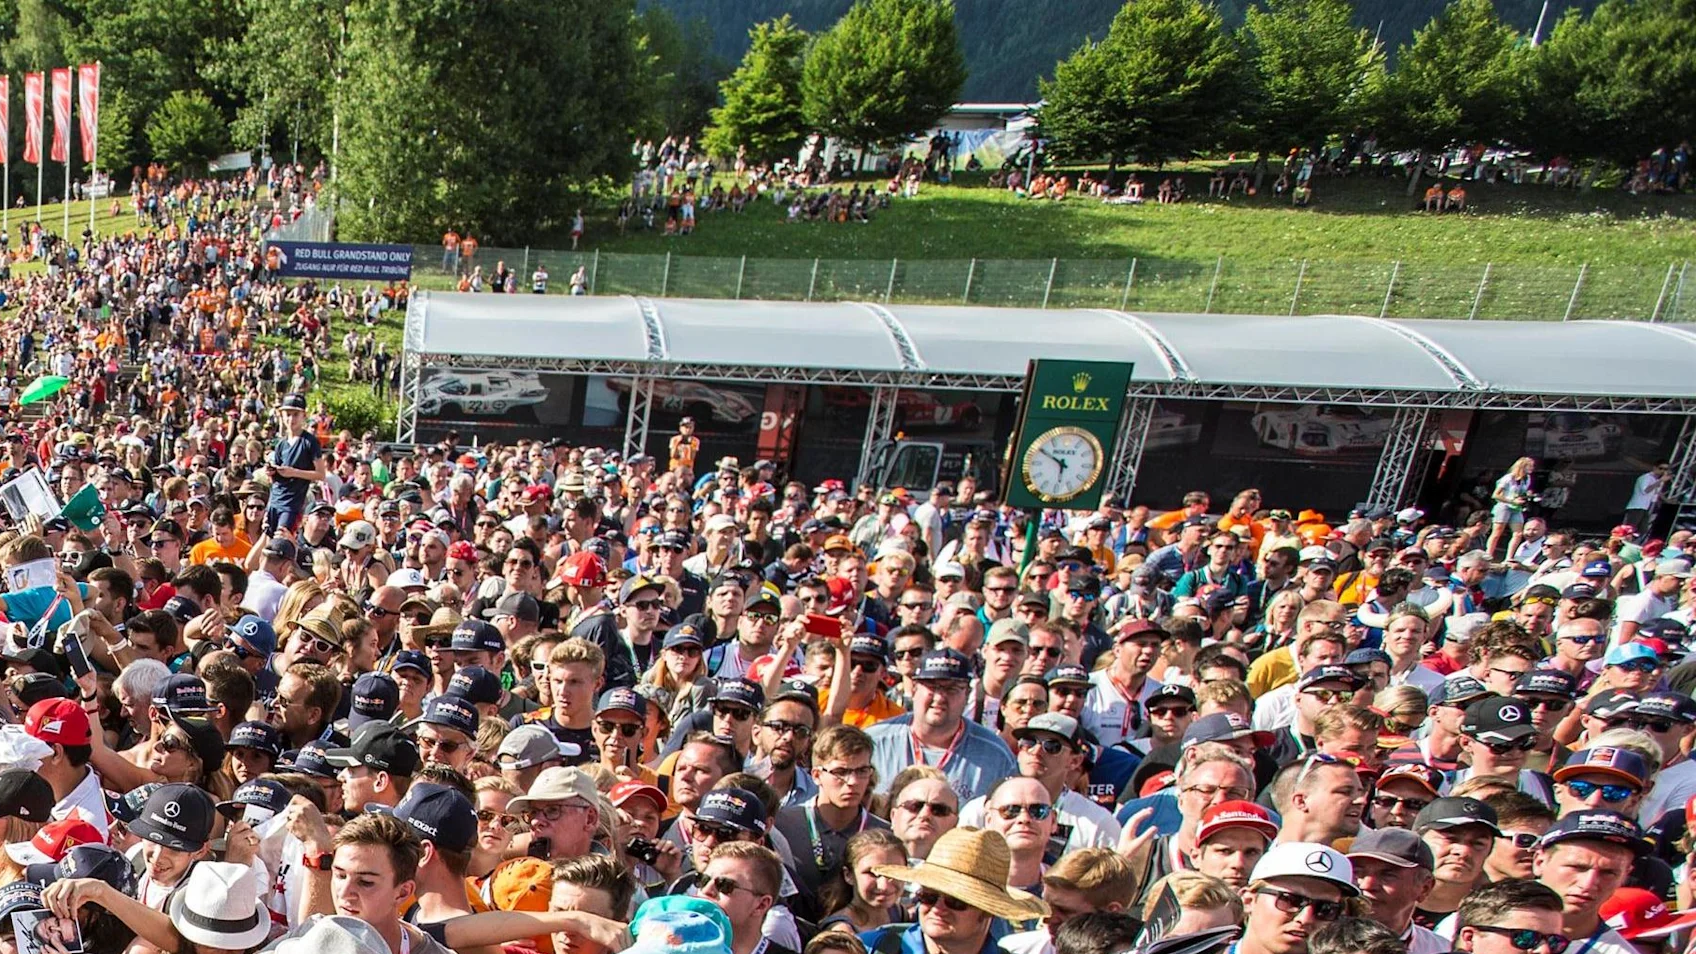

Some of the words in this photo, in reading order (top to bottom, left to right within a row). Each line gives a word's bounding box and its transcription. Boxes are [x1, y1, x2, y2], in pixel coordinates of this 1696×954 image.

[294, 248, 310, 259] RED
[312, 248, 332, 260] BULL
[333, 249, 388, 261] GRANDSTAND
[389, 251, 411, 262] ONLY
[1042, 394, 1110, 411] ROLEX
